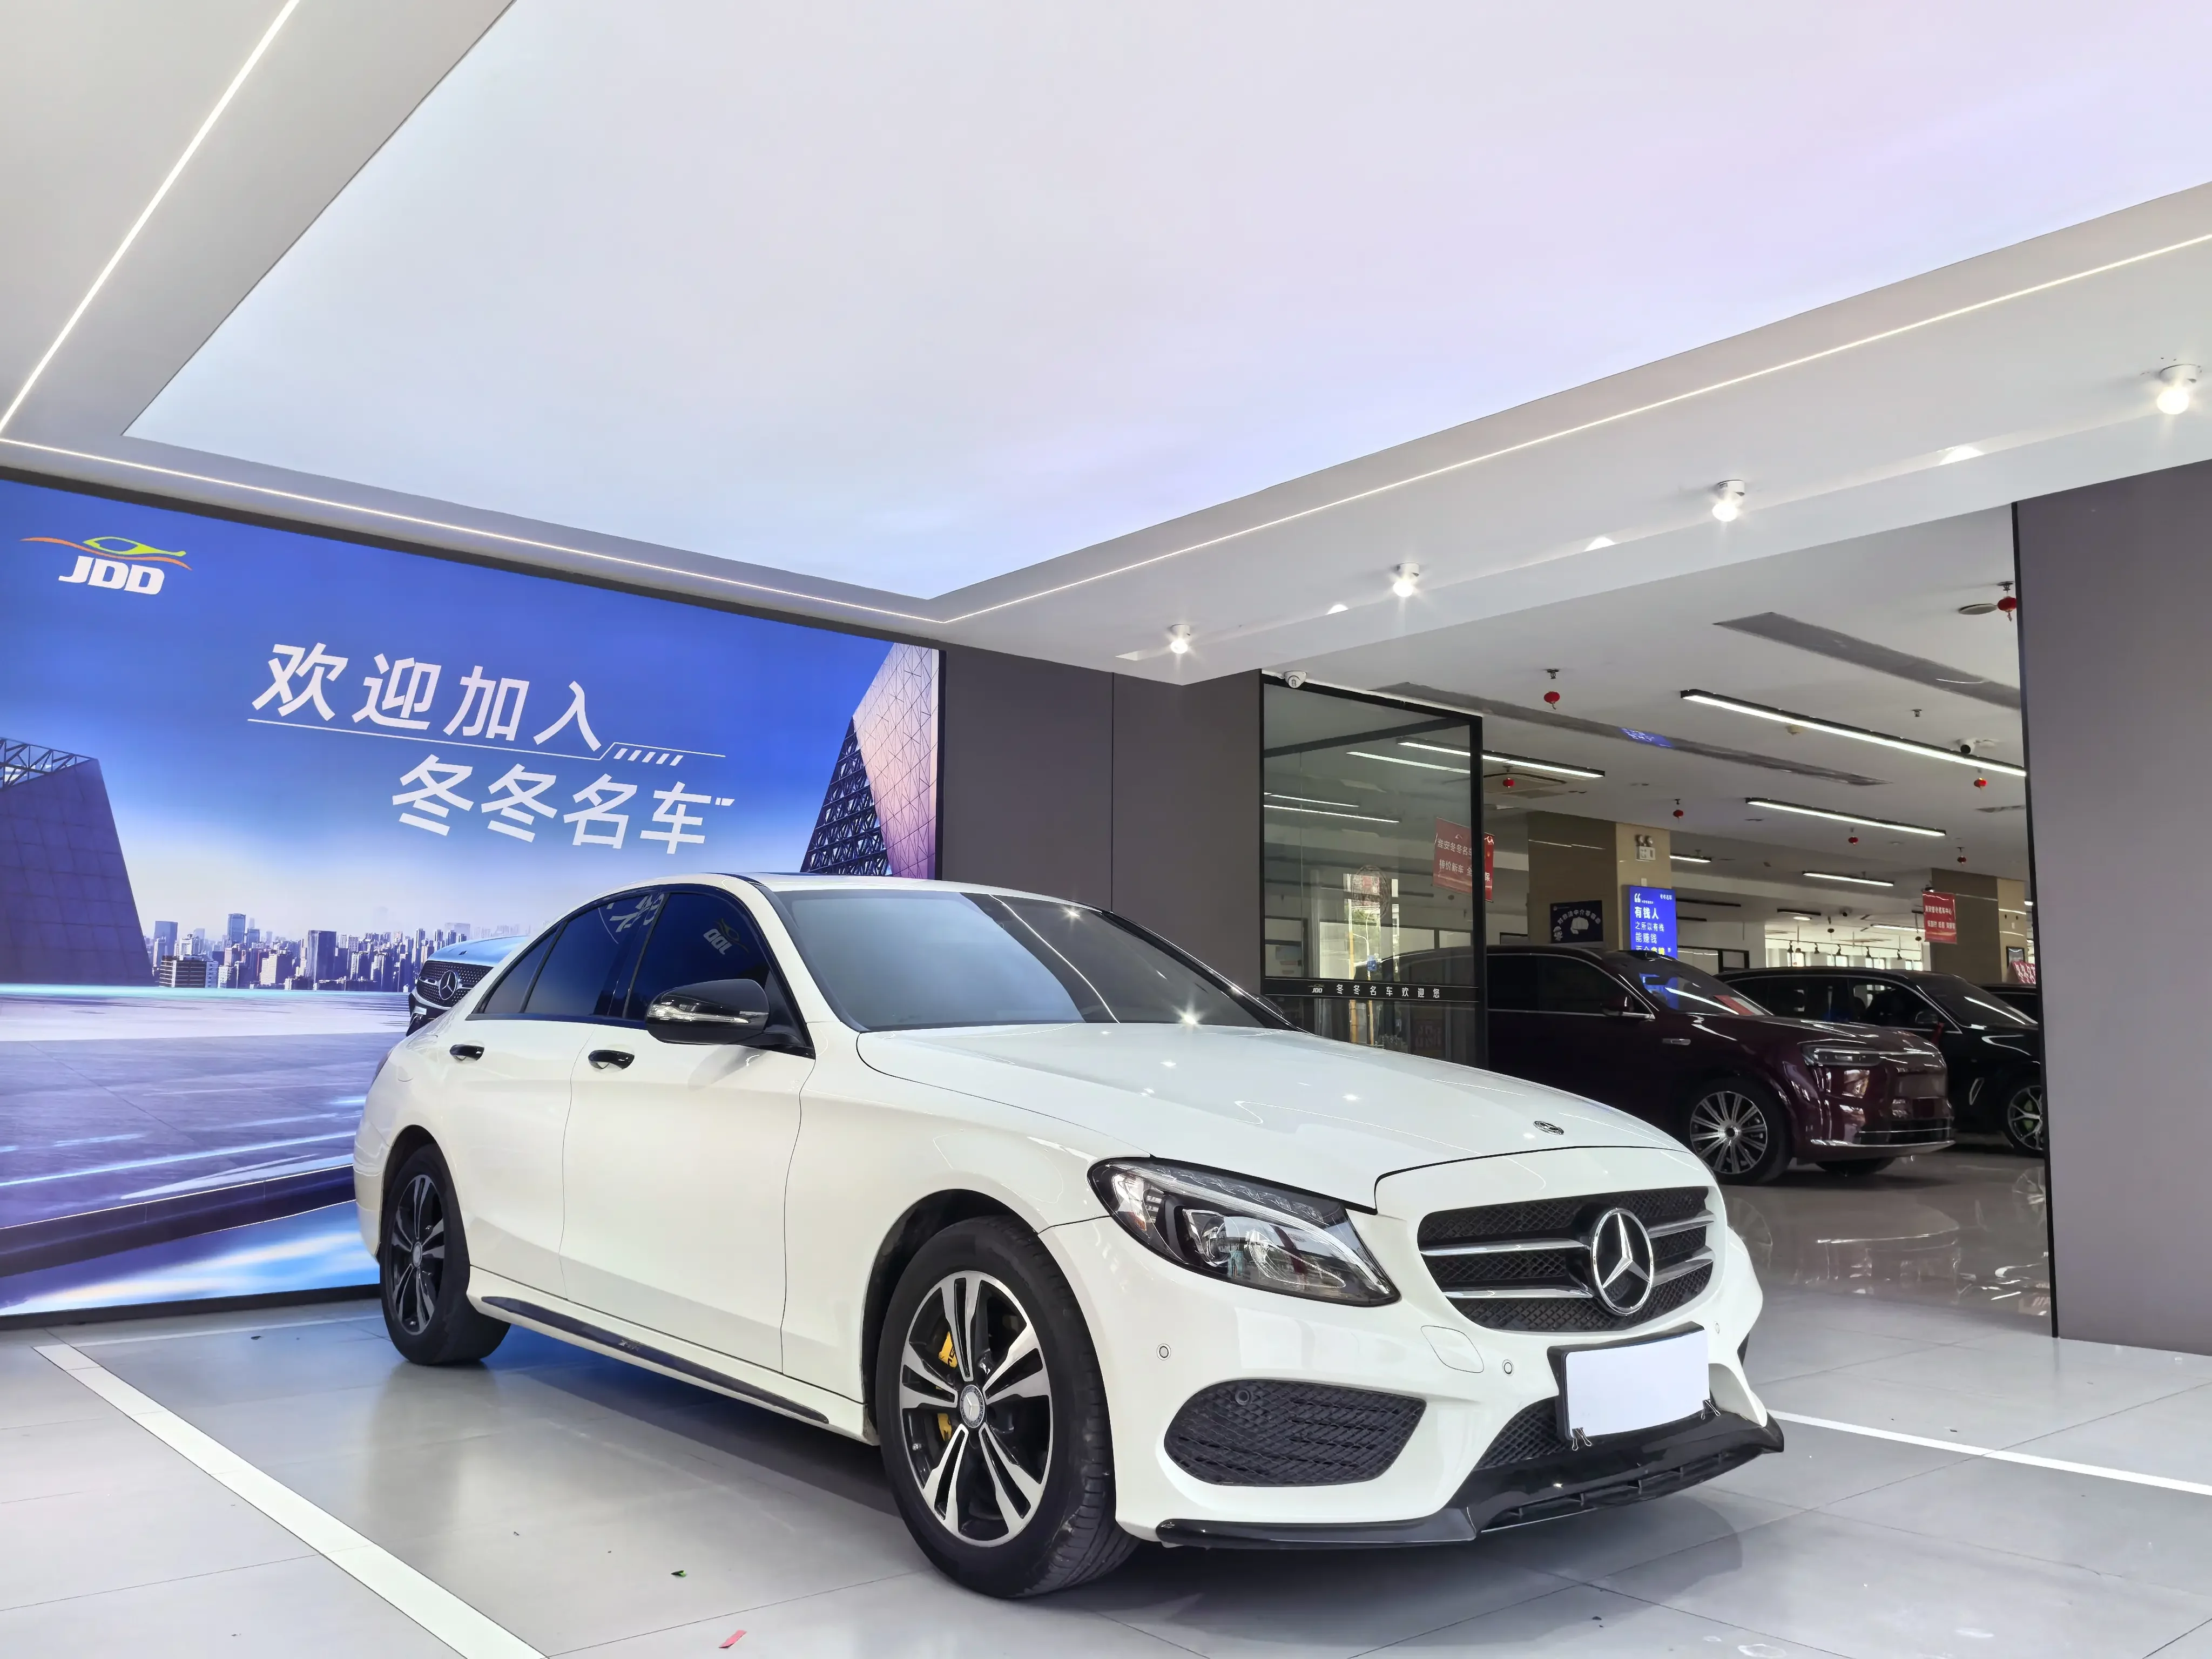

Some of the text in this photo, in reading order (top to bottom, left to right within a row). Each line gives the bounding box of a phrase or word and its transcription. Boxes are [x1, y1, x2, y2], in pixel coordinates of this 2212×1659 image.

[58, 556, 165, 595] JDD
[252, 642, 602, 752] 欢迎加入
[392, 754, 712, 854] 冬冬名车
[1634, 906, 1659, 919] 有钱人
[1635, 921, 1664, 932] 之所以有钱
[1635, 932, 1657, 944] 能赚钱
[1336, 984, 1440, 999] 冬冬名车欢迎您
